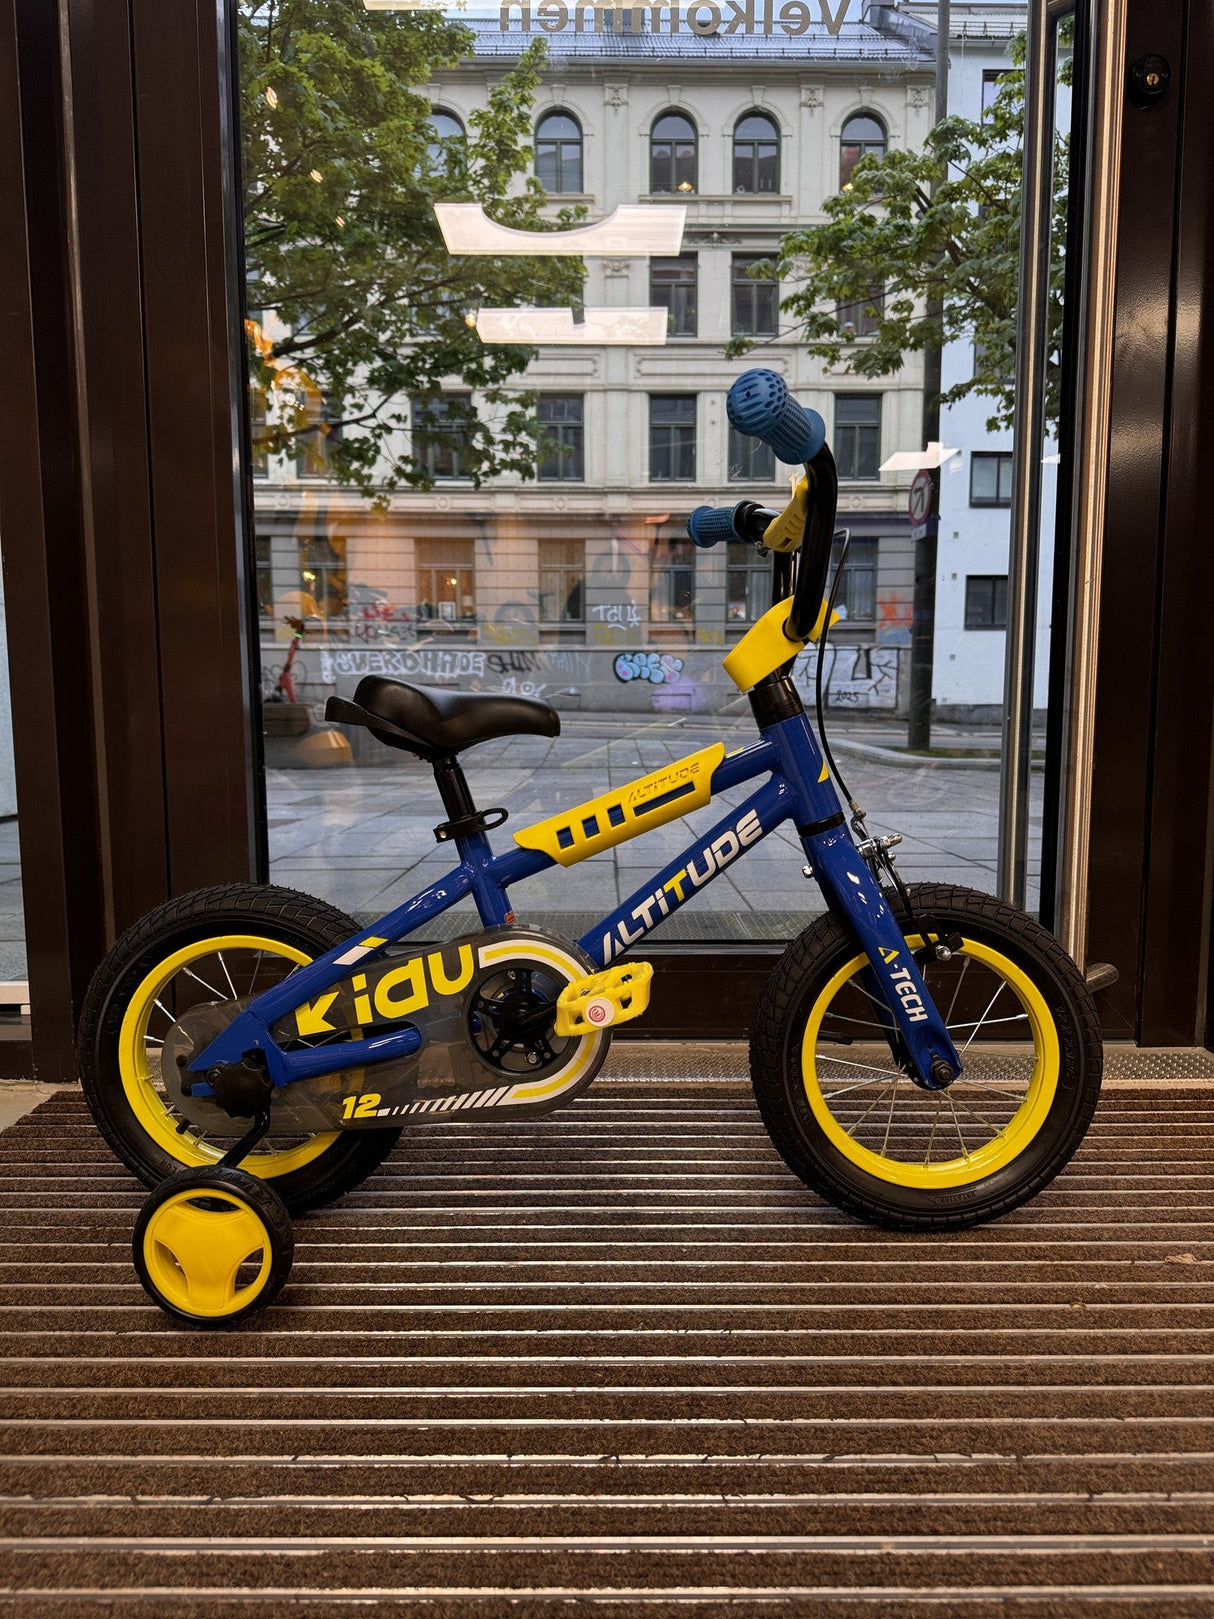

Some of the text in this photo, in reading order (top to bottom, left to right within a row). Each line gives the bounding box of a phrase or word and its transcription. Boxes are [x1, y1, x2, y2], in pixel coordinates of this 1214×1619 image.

[627, 762, 700, 804] ALTITUDE
[603, 808, 763, 966] ALTITUDE
[342, 1093, 382, 1120] 12
